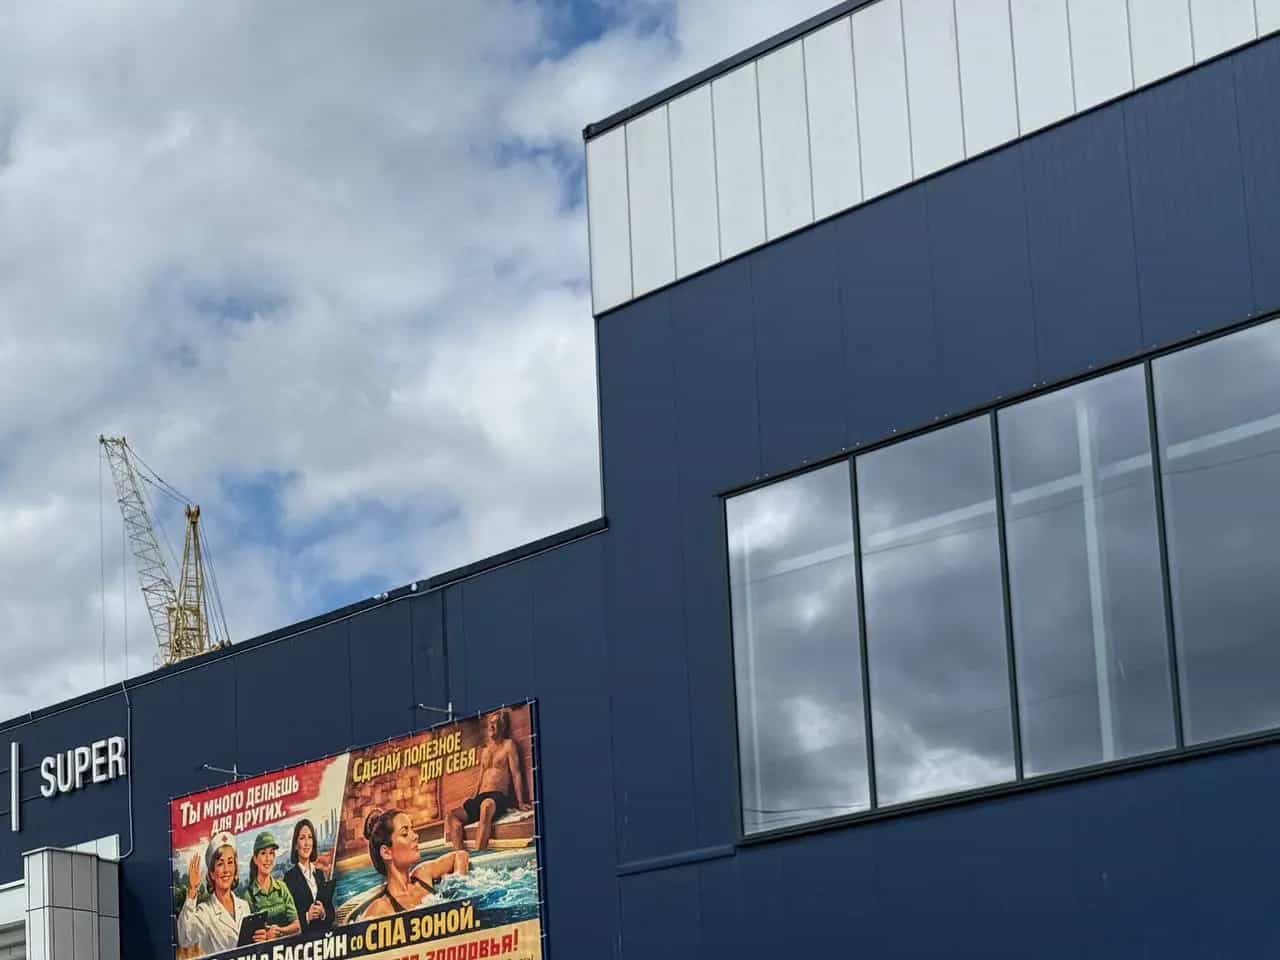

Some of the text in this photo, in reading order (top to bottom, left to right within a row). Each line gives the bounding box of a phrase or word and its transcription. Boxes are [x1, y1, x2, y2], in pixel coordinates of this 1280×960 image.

[40, 736, 128, 798] SUPER
[365, 914, 407, 951] СПА
[410, 900, 481, 942] ЗОНОЙ.
